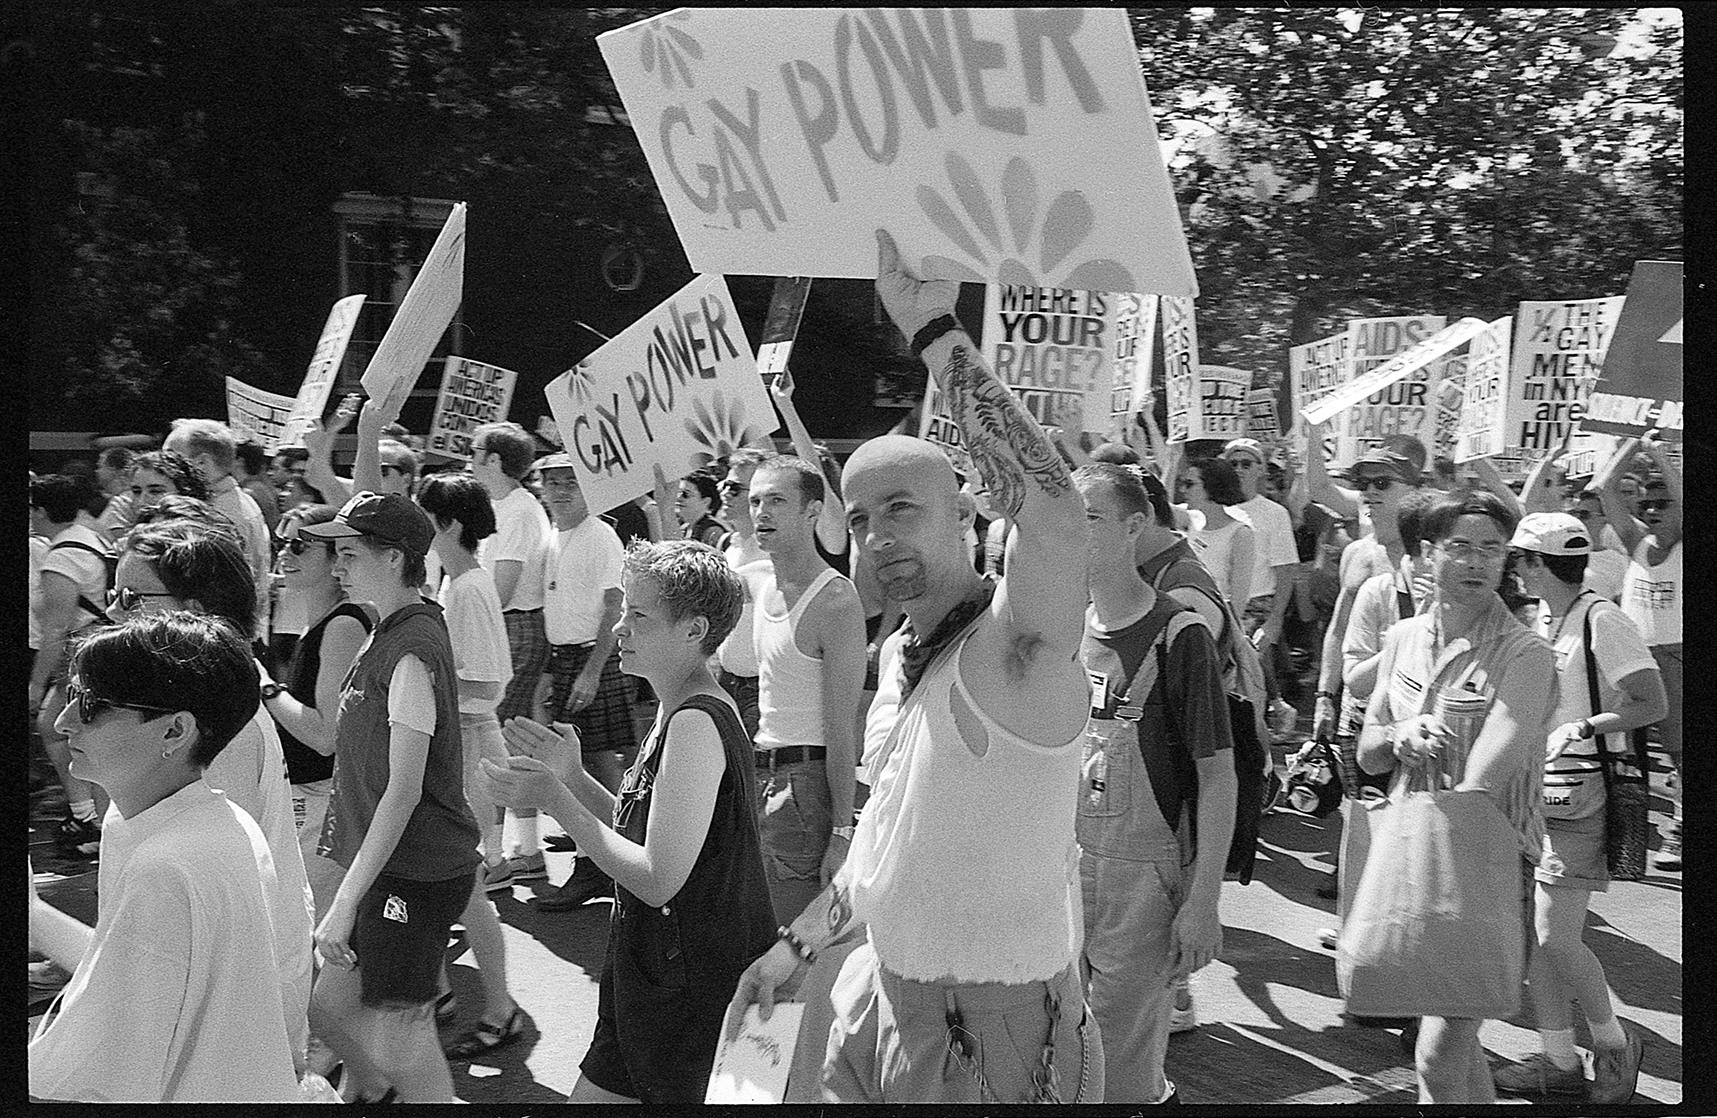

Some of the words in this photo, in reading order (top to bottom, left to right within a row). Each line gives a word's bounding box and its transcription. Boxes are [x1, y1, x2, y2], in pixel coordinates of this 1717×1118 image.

[660, 87, 788, 232] GAY
[780, 8, 1107, 204] POWER
[1001, 283, 1078, 314] WHERE
[1564, 302, 1607, 326] THE
[1000, 312, 1105, 348] YOUR
[1557, 325, 1609, 350] GAY
[996, 343, 1103, 392] RAGE?
[1533, 353, 1603, 378] MEN
[573, 392, 633, 477] GAY
[626, 293, 740, 443] POWER
[1357, 383, 1427, 406] OUR
[1524, 375, 1545, 400] in
[1351, 406, 1426, 437] RAGE?
[1535, 402, 1586, 422] are
[926, 419, 963, 447] AID
